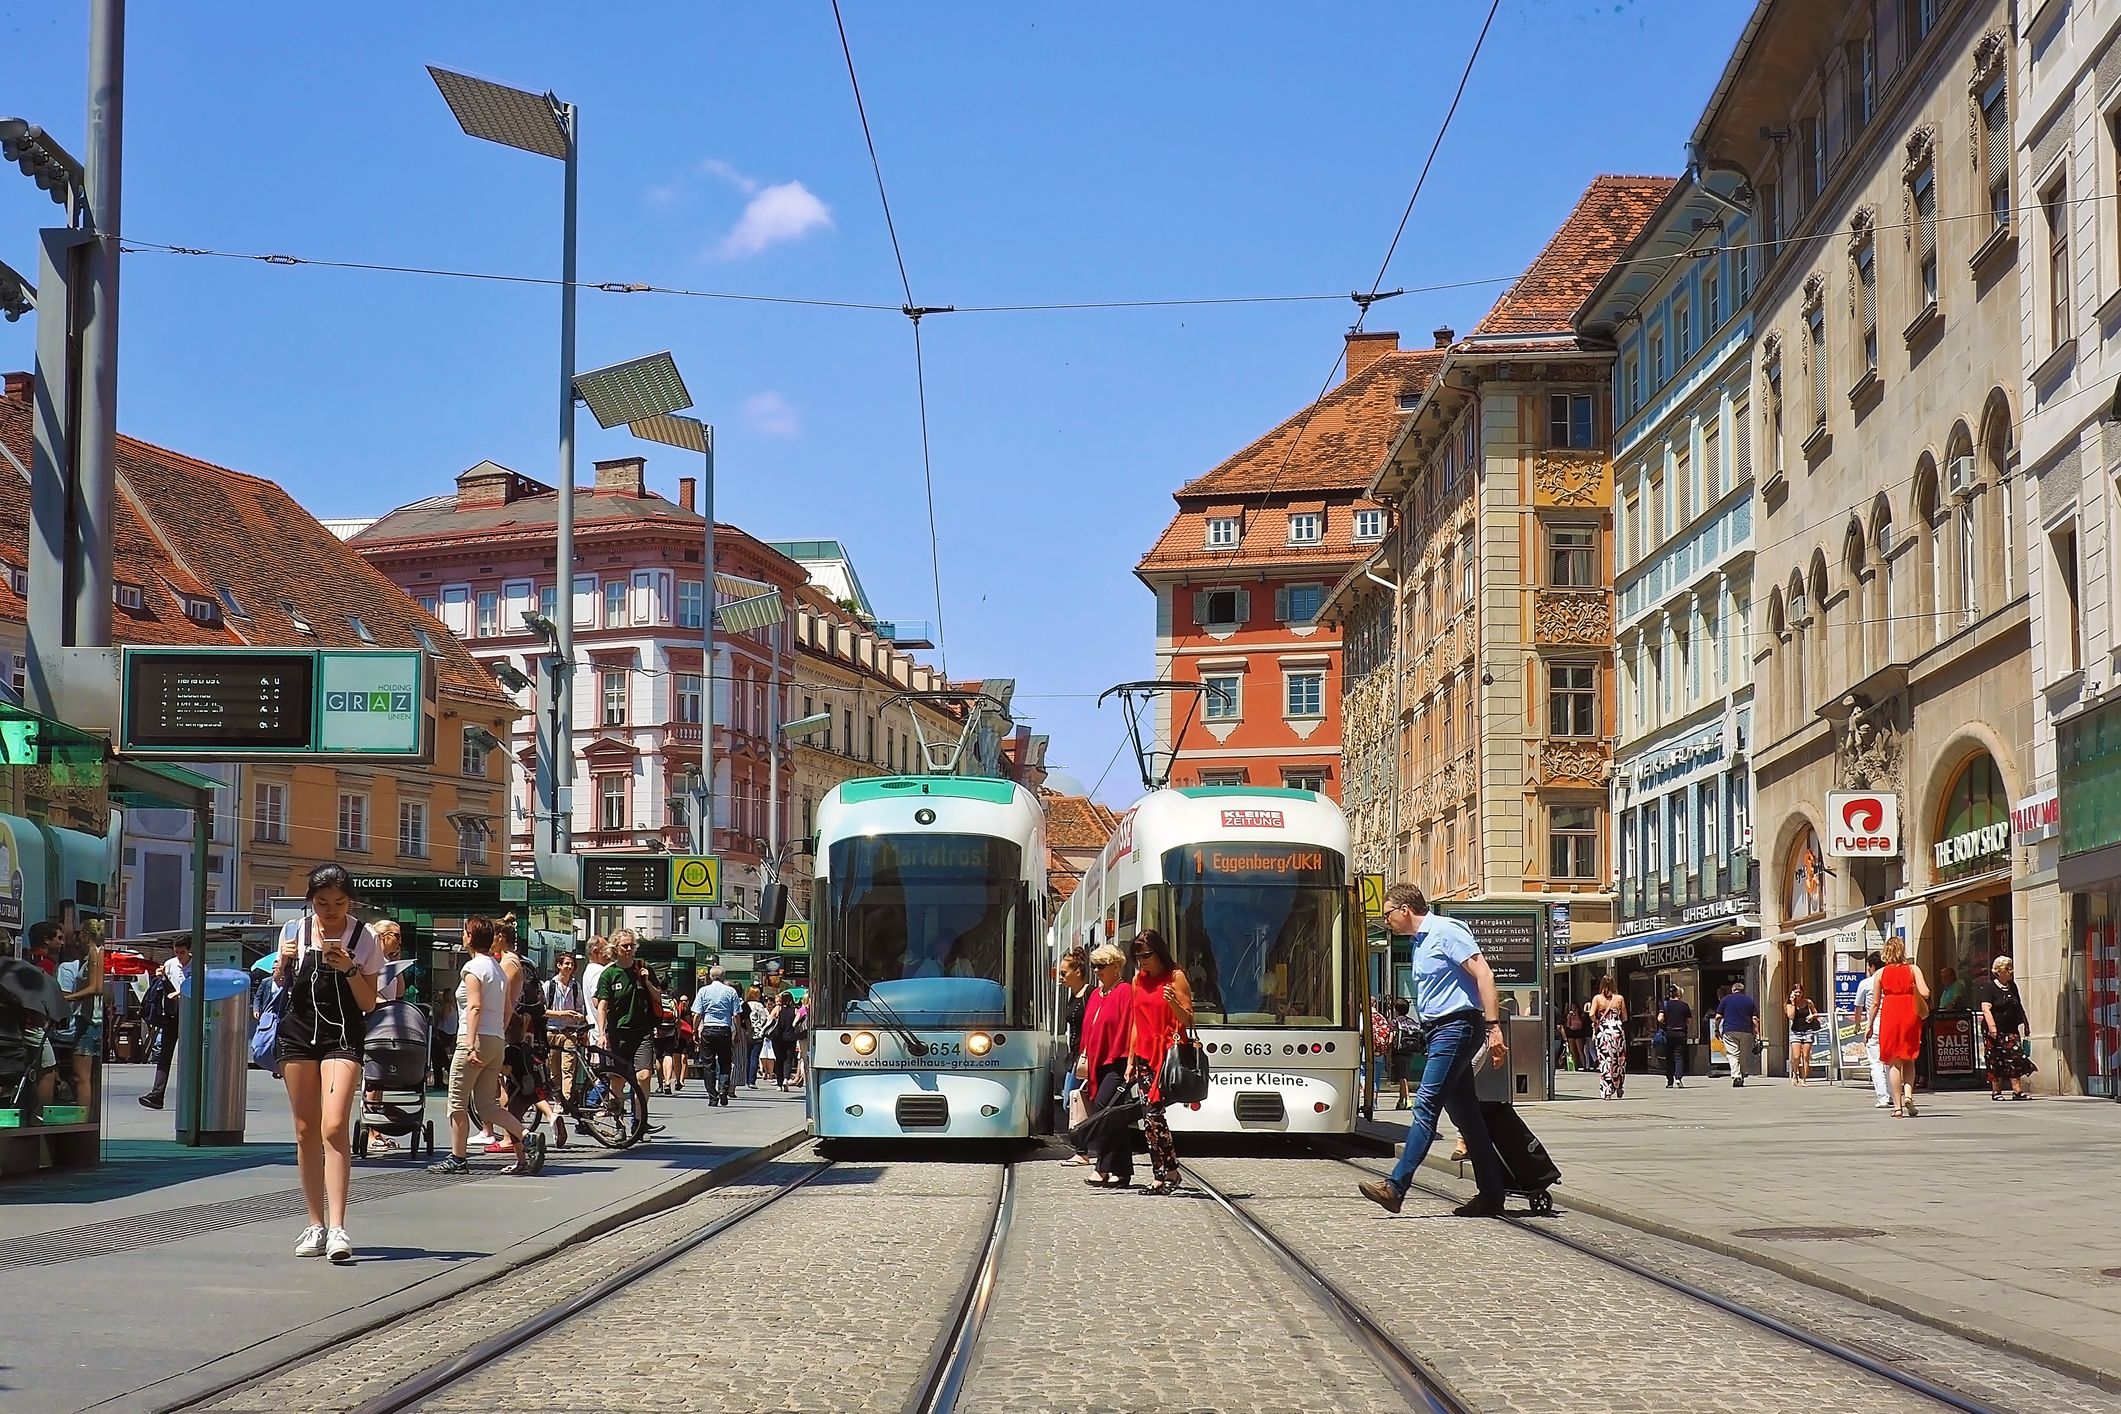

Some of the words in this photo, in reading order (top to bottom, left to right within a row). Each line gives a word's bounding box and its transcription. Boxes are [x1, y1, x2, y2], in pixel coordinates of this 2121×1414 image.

[328, 694, 408, 710] GRAZ
[1224, 811, 1281, 819] KLEINE
[2011, 805, 2038, 834] TALLY
[1225, 817, 1282, 827] ZEITUNG
[1835, 837, 1891, 851] ruefa
[1934, 839, 1953, 868] THE
[1953, 829, 1981, 862] BODY
[1980, 822, 2009, 855] SHOP
[1193, 850, 1203, 874] 1
[1213, 853, 1322, 873] Eggenberg/UKH
[352, 878, 393, 888] TICKETS
[439, 878, 479, 888] TICKETS
[1639, 943, 1695, 966] WEIKHARD
[1936, 1034, 1969, 1047] SALE
[929, 1042, 961, 1056] 654
[1244, 1043, 1272, 1056] 663
[1937, 1047, 1970, 1056] GROSSE
[837, 1057, 1000, 1069] www.schauspielhaus-graz.com
[1208, 1073, 1252, 1085] Meine
[1256, 1073, 1309, 1087] Kleine.
